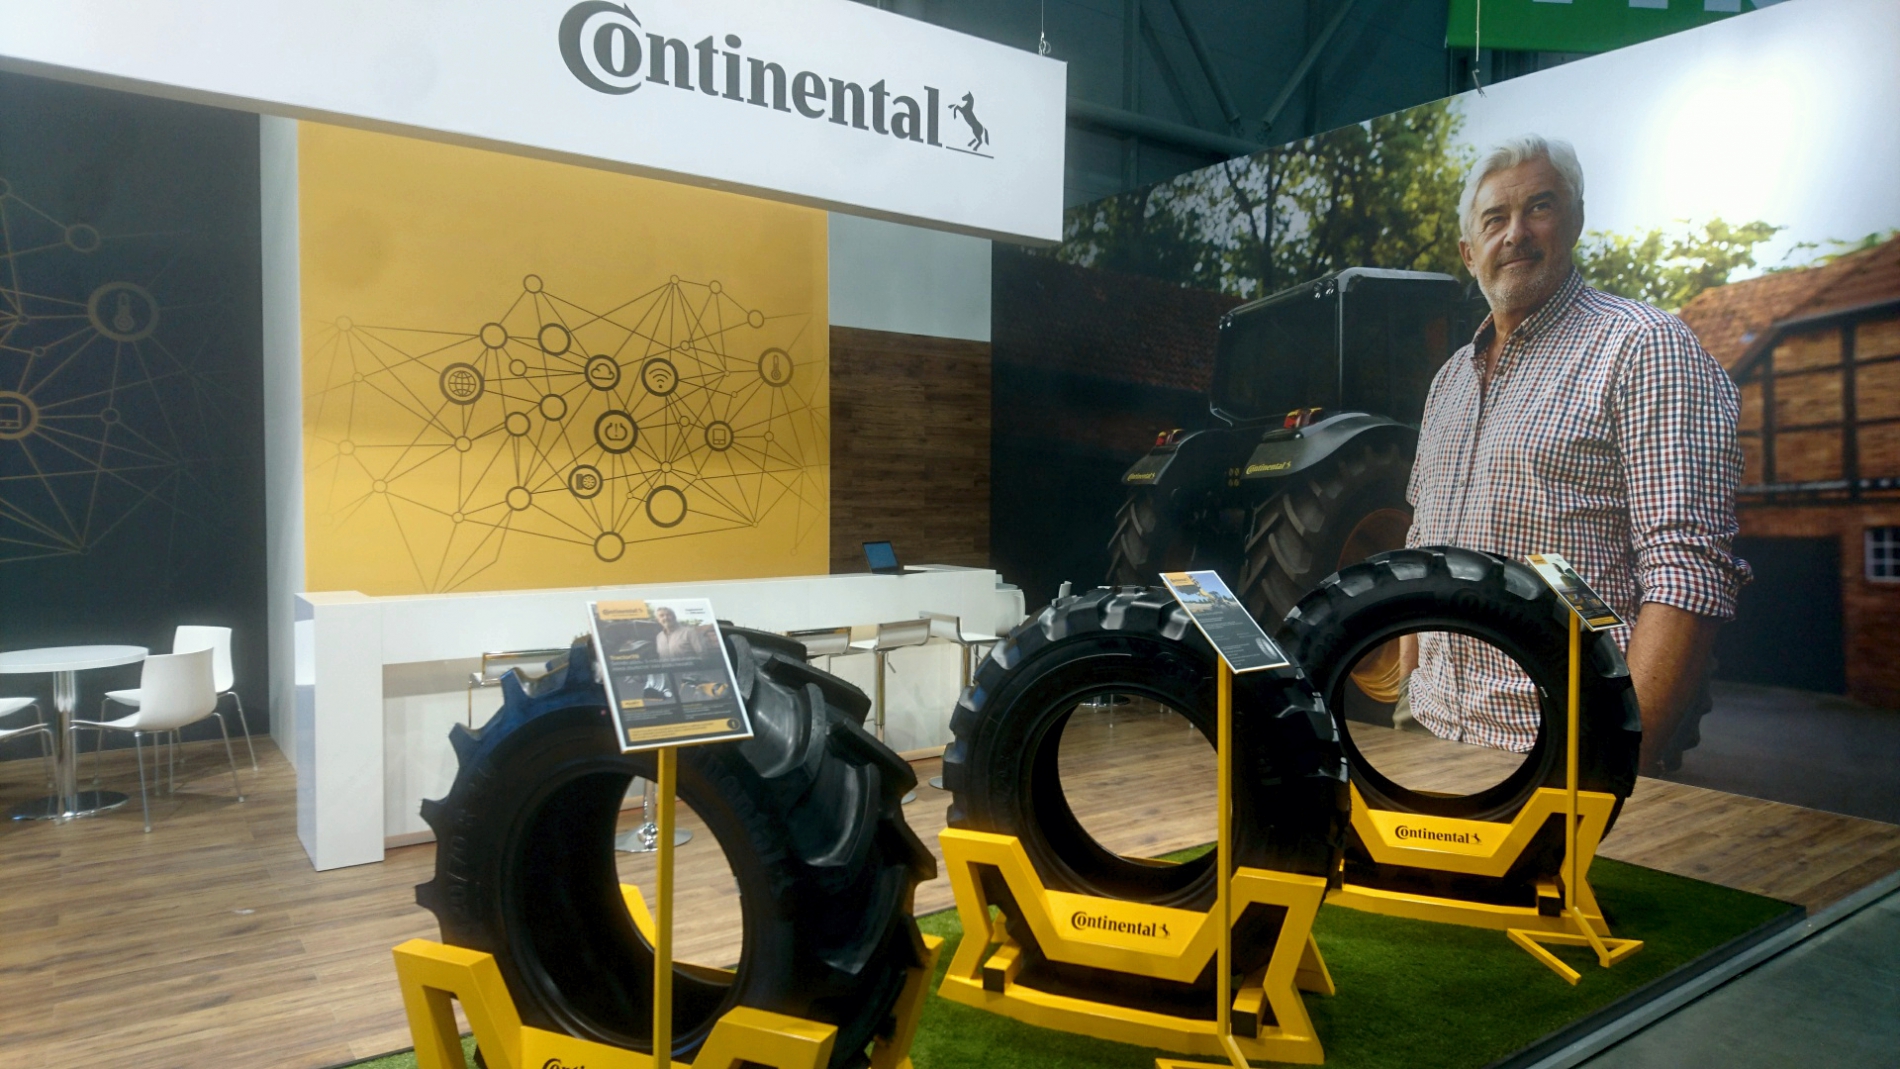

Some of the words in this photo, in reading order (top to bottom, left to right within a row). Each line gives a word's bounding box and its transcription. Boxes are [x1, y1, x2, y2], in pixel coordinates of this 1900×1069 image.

[558, 0, 943, 147] Continental
[1245, 461, 1285, 475] Continental
[1394, 825, 1470, 844] Continental
[1070, 911, 1157, 938] Continental
